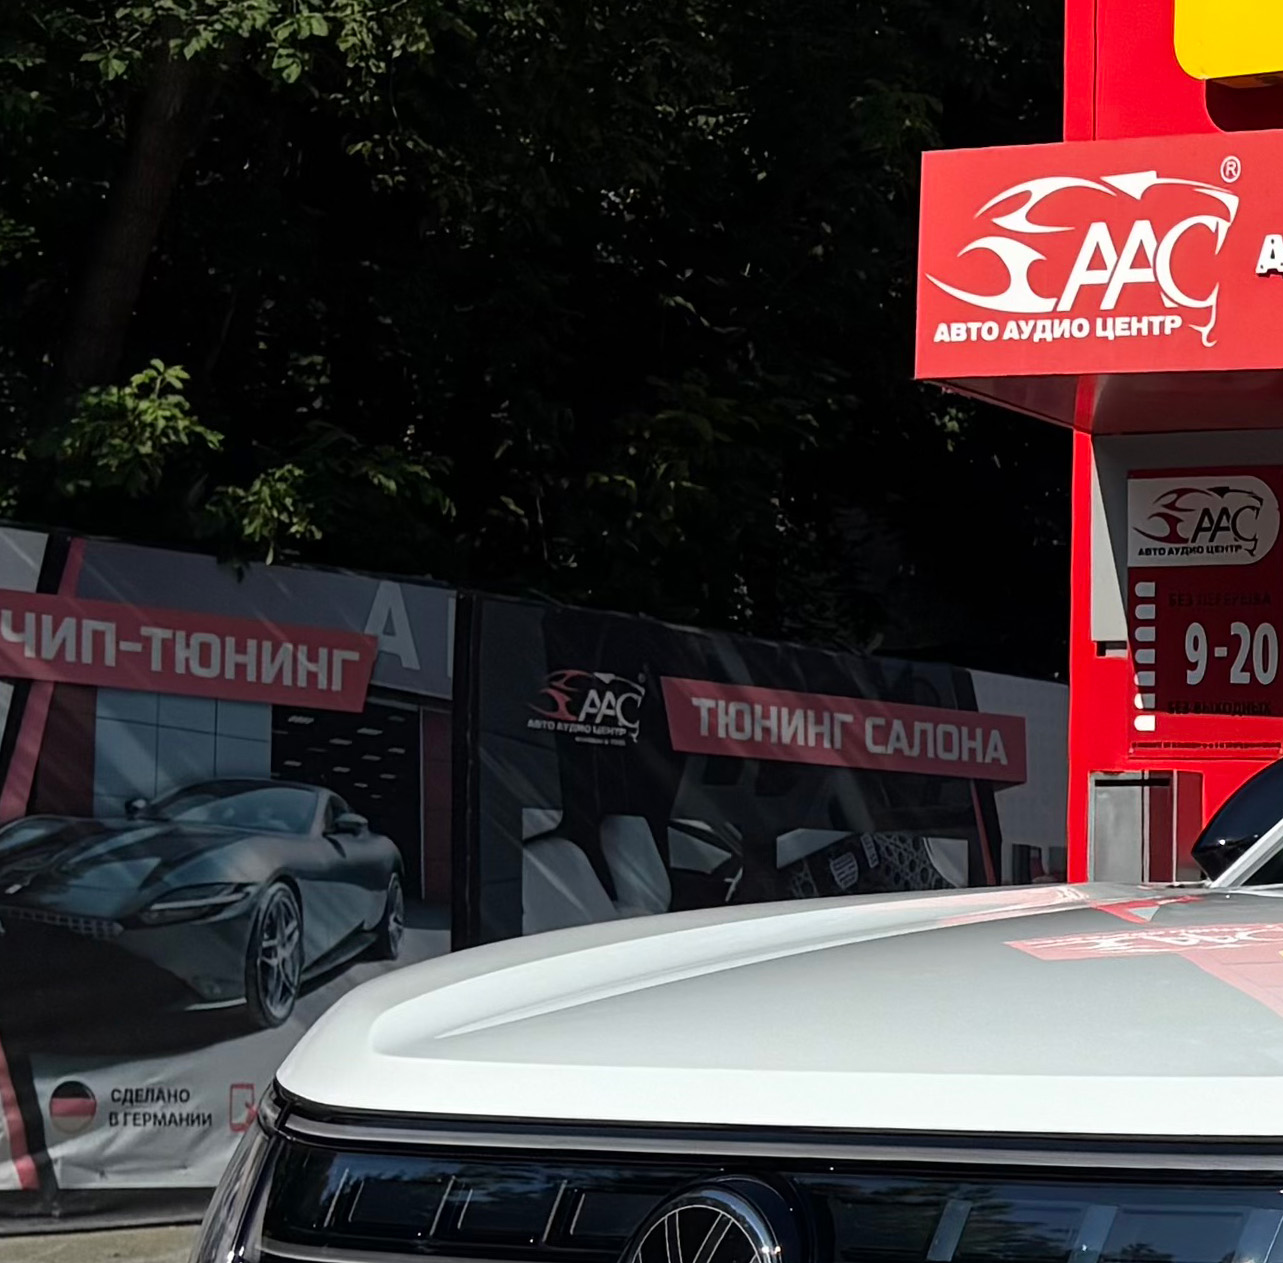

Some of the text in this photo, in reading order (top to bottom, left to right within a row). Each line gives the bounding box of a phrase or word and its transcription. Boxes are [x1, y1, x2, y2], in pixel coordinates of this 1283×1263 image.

[933, 315, 1183, 343] АВТО АУДИО ЦЕНТР
[1138, 544, 1243, 557] АВТО АУДИО ЦЕНТР
[0, 608, 360, 692] ЧИП-ТЮНИНГ
[691, 697, 1009, 766] ТЮНИНГ САЛОНА
[110, 1087, 191, 1107] СДЕЛАНО
[109, 1111, 213, 1128] В ГЕРМАНИИ
